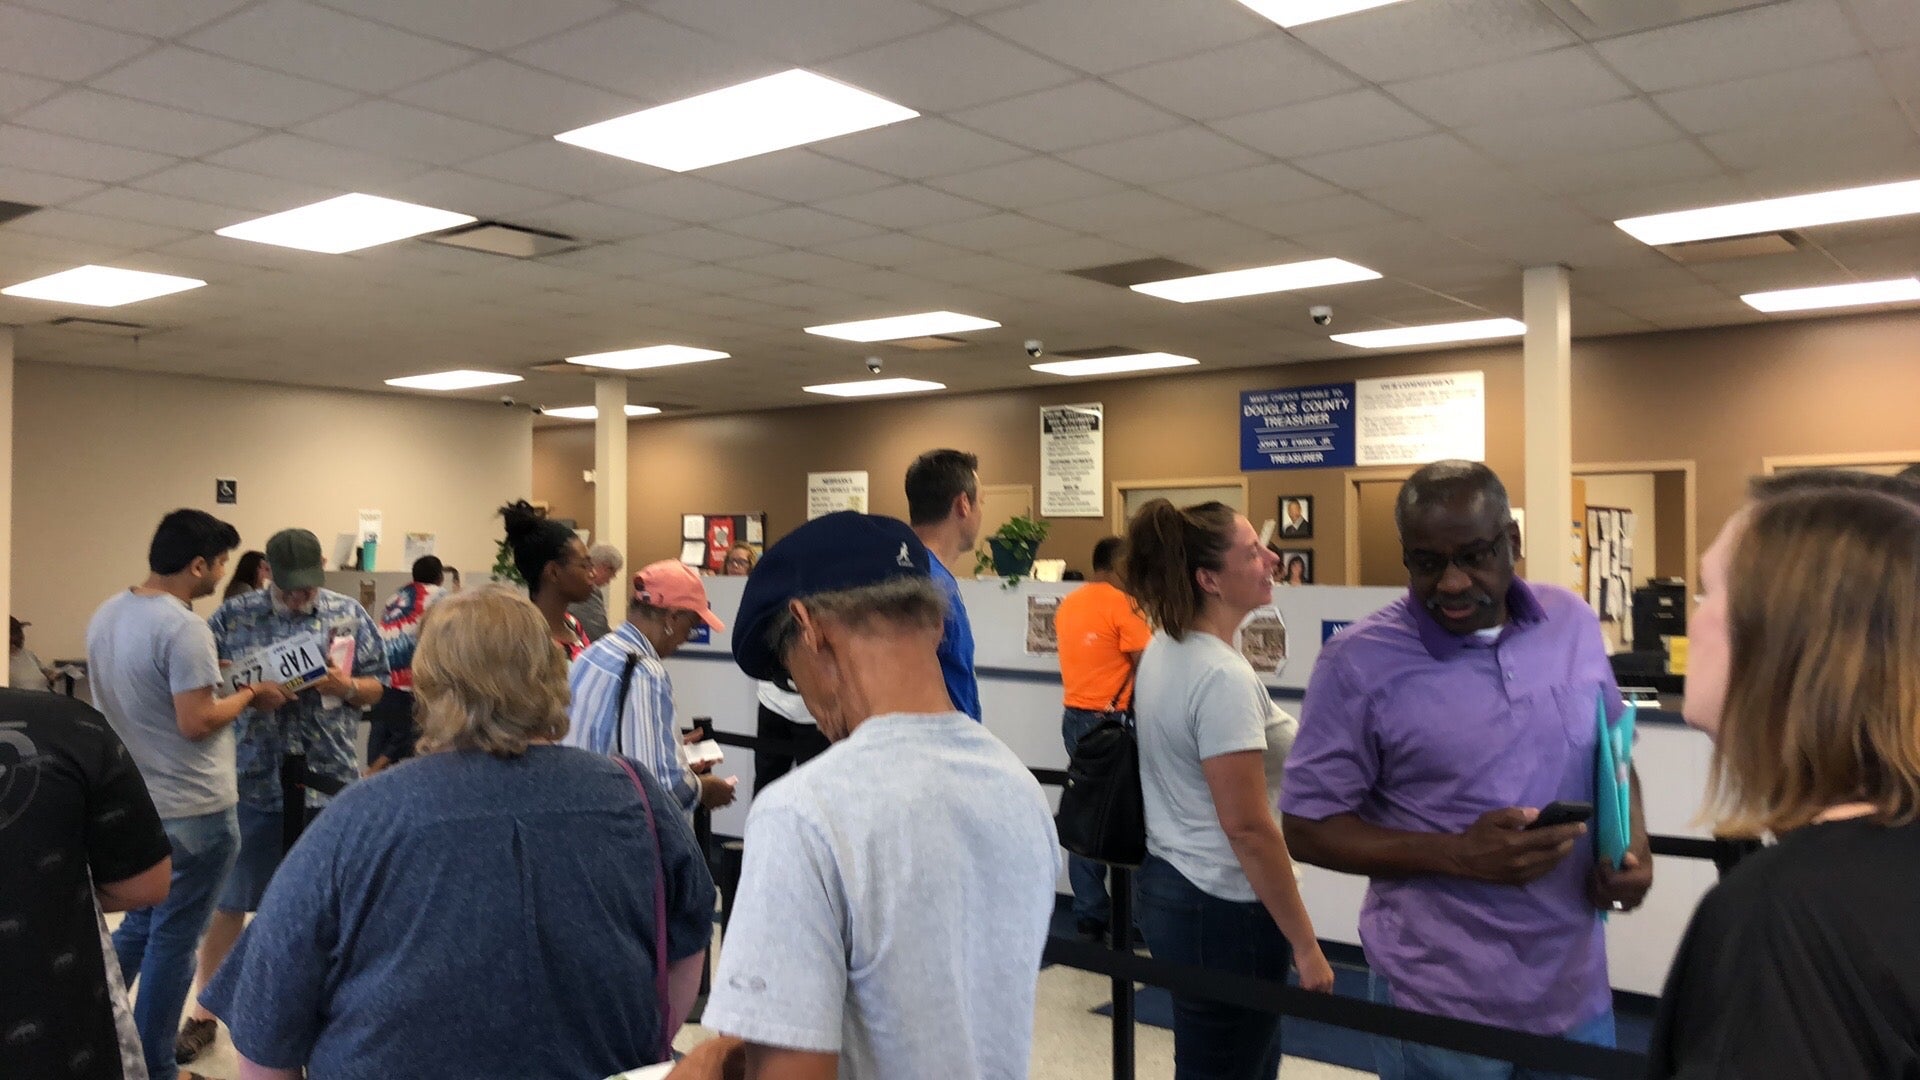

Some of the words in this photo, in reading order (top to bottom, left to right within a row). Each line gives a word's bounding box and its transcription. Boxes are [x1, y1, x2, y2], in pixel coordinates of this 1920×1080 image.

[1244, 401, 1298, 417] DOUGLAS
[1301, 397, 1350, 413] COUNTY
[1263, 412, 1330, 428] TREASURER
[1269, 452, 1324, 465] TREASURER
[280, 646, 314, 678] VAP
